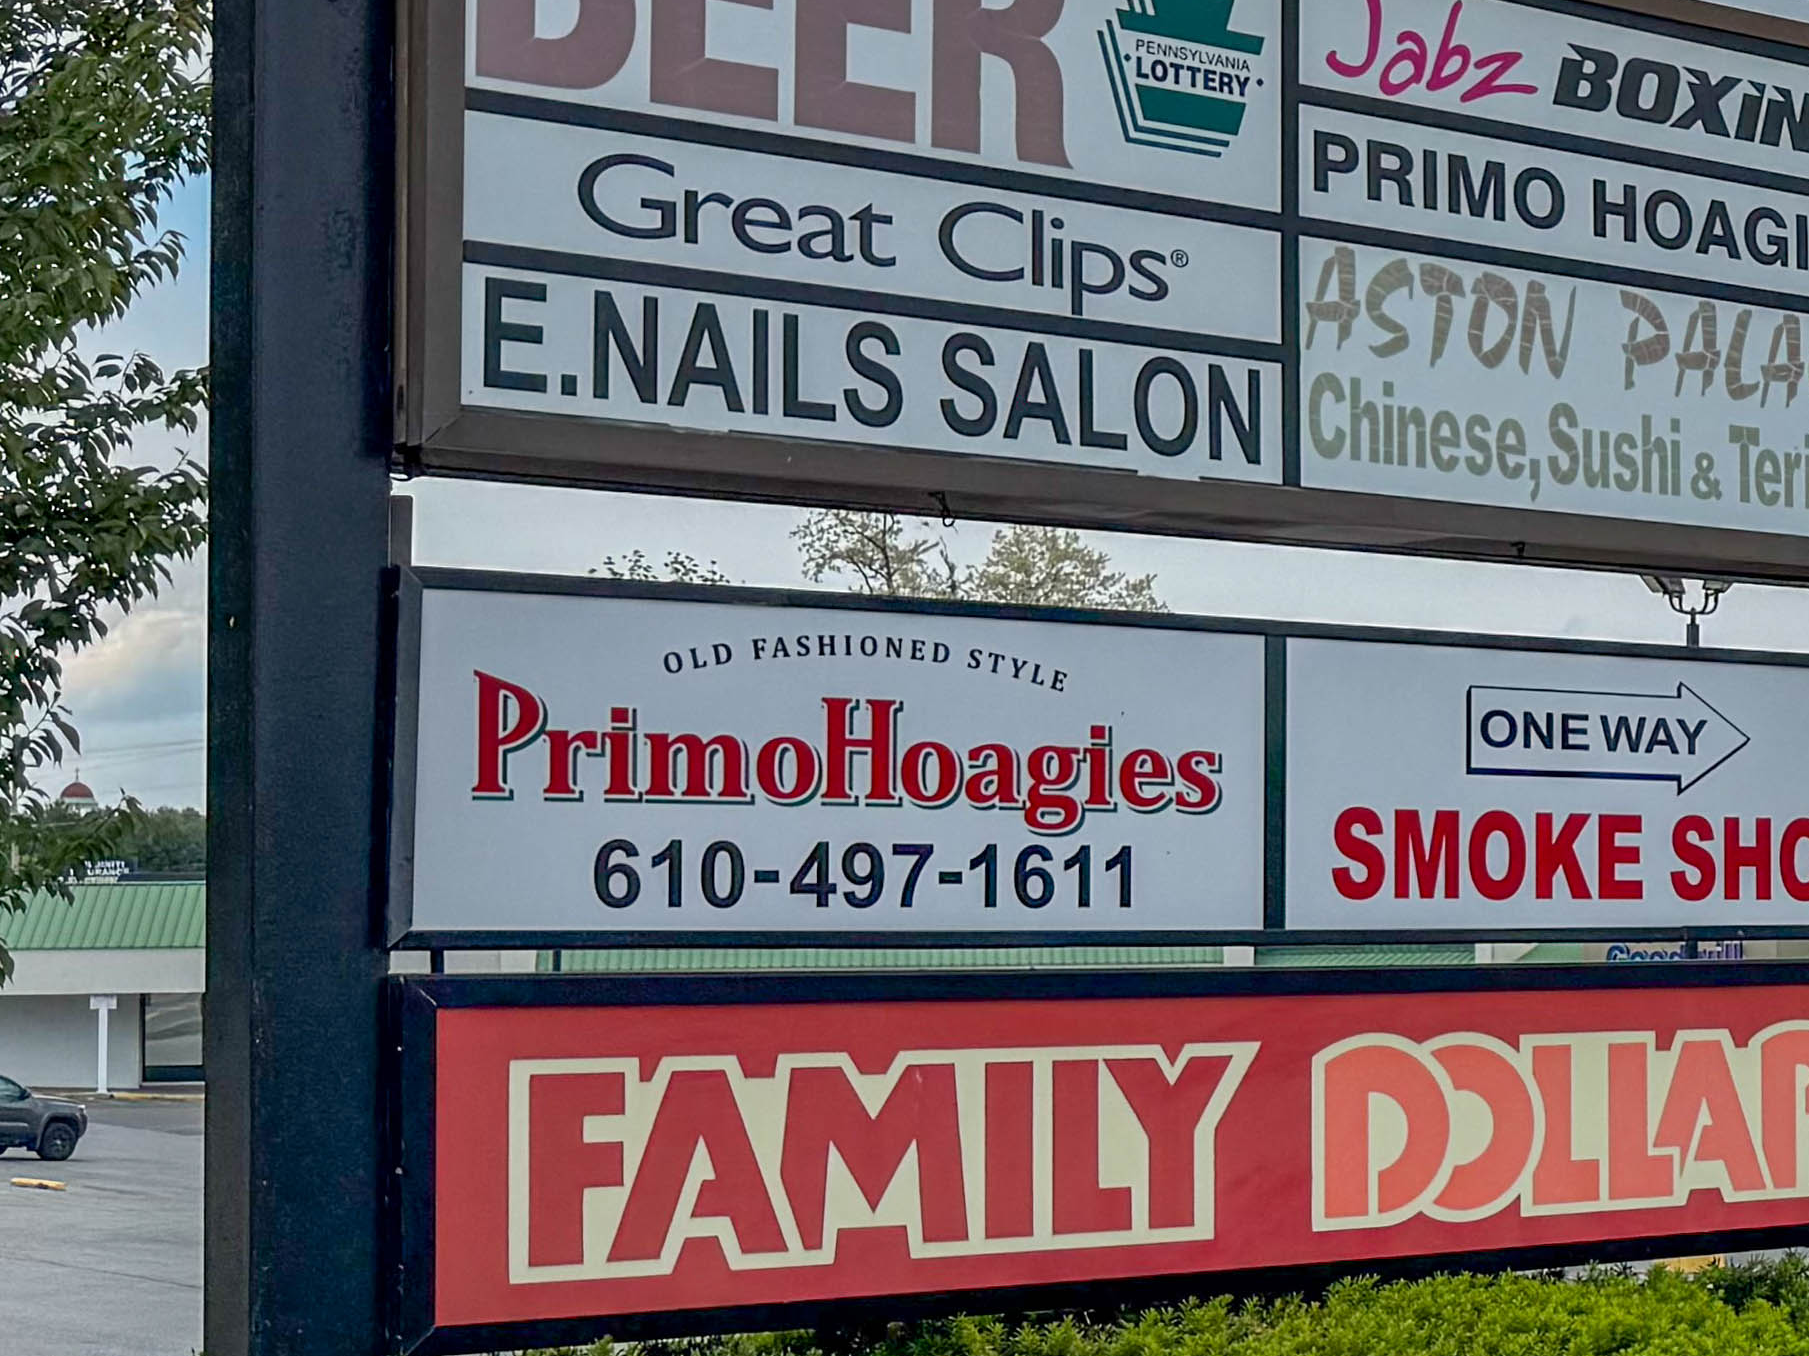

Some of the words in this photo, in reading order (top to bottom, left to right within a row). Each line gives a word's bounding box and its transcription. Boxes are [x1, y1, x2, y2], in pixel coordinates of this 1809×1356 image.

[1135, 38, 1251, 73] PENNSYLVANIA
[1135, 56, 1251, 97] LOTTERY
[577, 152, 897, 267] Great
[1312, 129, 1566, 230] PRIMO
[1304, 245, 1577, 380] ASTON
[484, 275, 904, 428] E.NAILS
[940, 331, 1262, 466] SALON
[1690, 451, 1723, 501] &
[663, 640, 733, 676] OLD
[751, 634, 951, 665] FASHIONED
[966, 647, 1070, 694] STYLE
[472, 668, 1223, 836] PrimoHoagies
[1479, 709, 1590, 752] ONE
[1599, 714, 1708, 756] WAY
[594, 838, 1134, 909] 610-497-1611
[1331, 806, 1644, 902] SMOKE
[509, 1041, 1262, 1285] FAMILY
